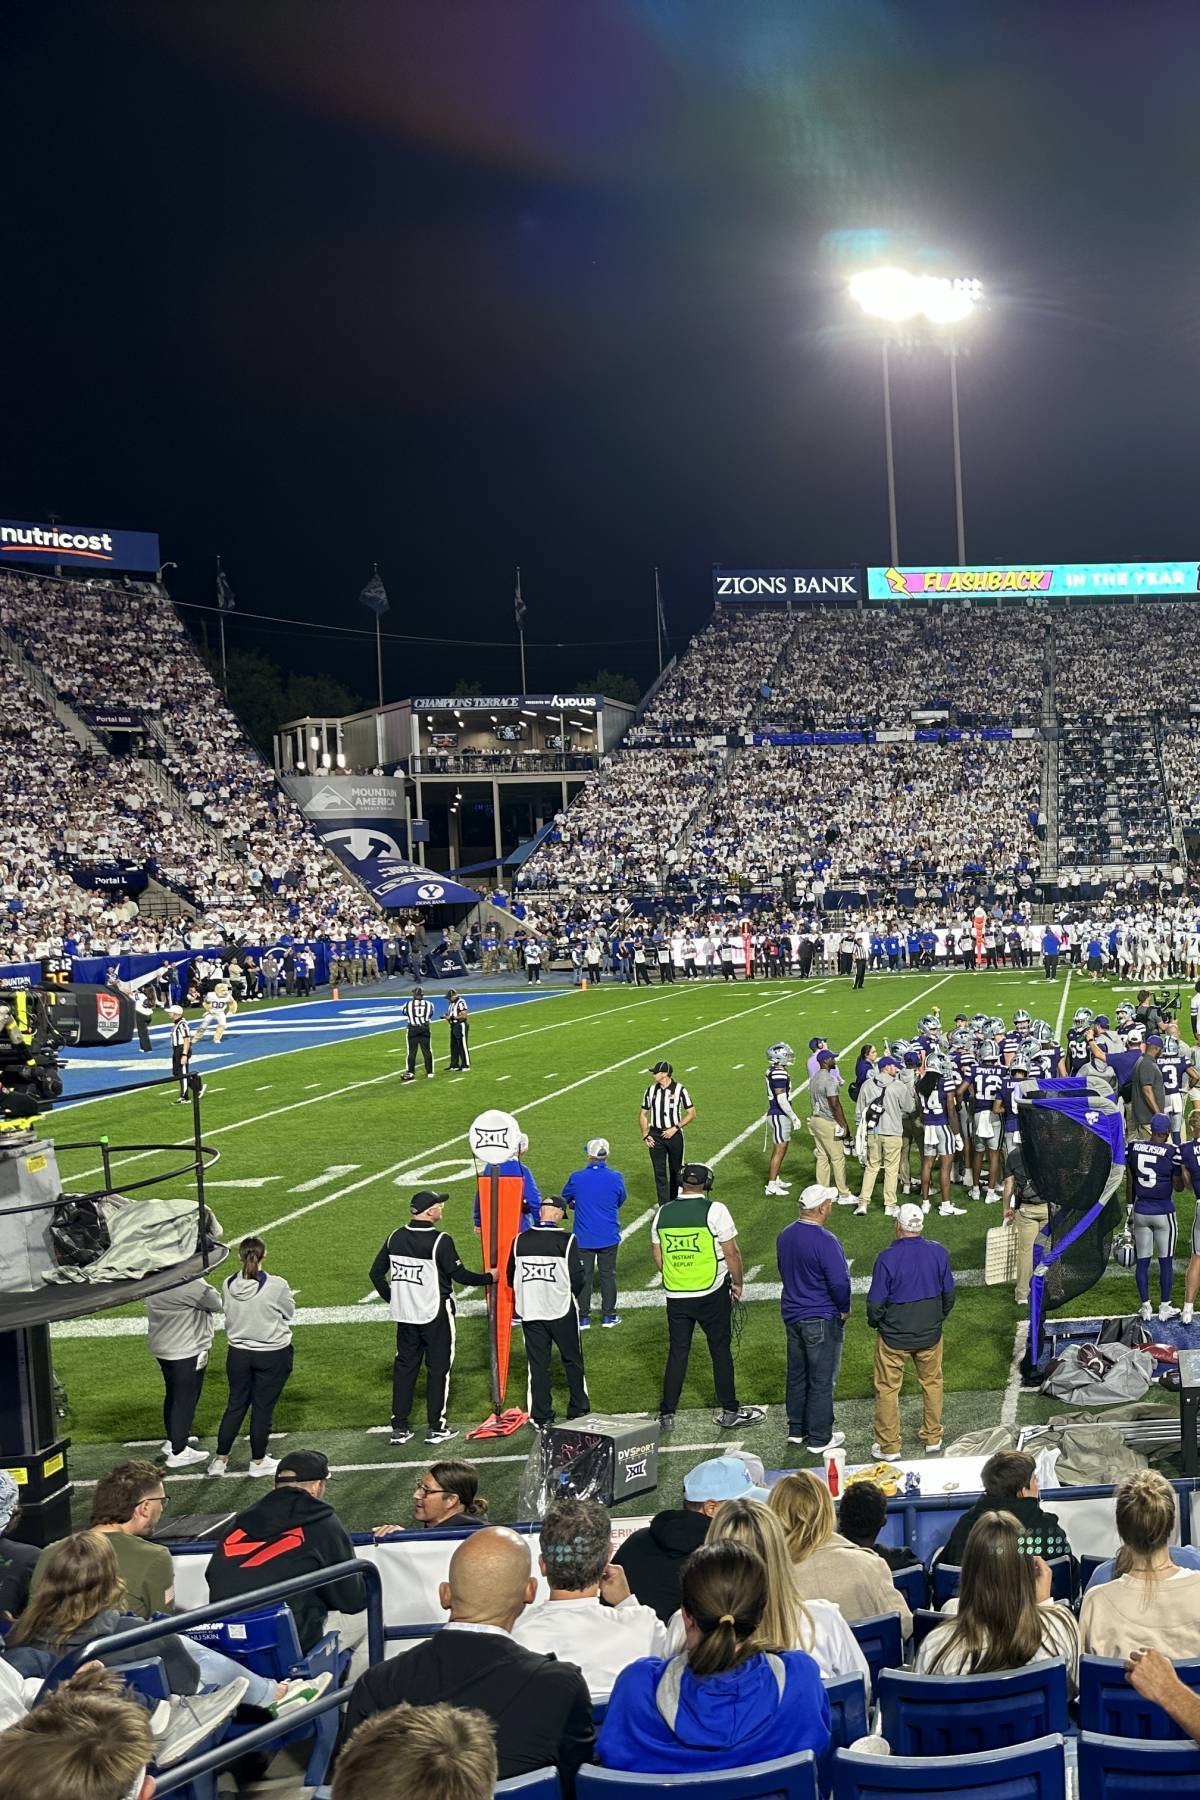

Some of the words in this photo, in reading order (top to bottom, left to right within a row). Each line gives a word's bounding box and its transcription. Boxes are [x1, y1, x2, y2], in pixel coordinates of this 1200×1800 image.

[1, 527, 113, 551] nutricost
[717, 577, 787, 594] ZIONS
[794, 576, 857, 593] BANK
[923, 571, 1045, 593] FLASHBACK
[1066, 573, 1085, 587] IN
[1094, 573, 1128, 587] THE
[1136, 571, 1184, 586] YEAR
[414, 698, 472, 708] CHAMPIONS
[473, 697, 519, 707] TERRACE
[351, 788, 397, 797] MOUNTAIN
[355, 797, 395, 806] AMERICA
[95, 876, 119, 884] Portal
[1068, 1041, 1087, 1059] 69
[1162, 1065, 1178, 1089] 3
[974, 1075, 1002, 1100] 12
[1132, 1143, 1168, 1157] ROBERSON
[1137, 1153, 1157, 1188] 5
